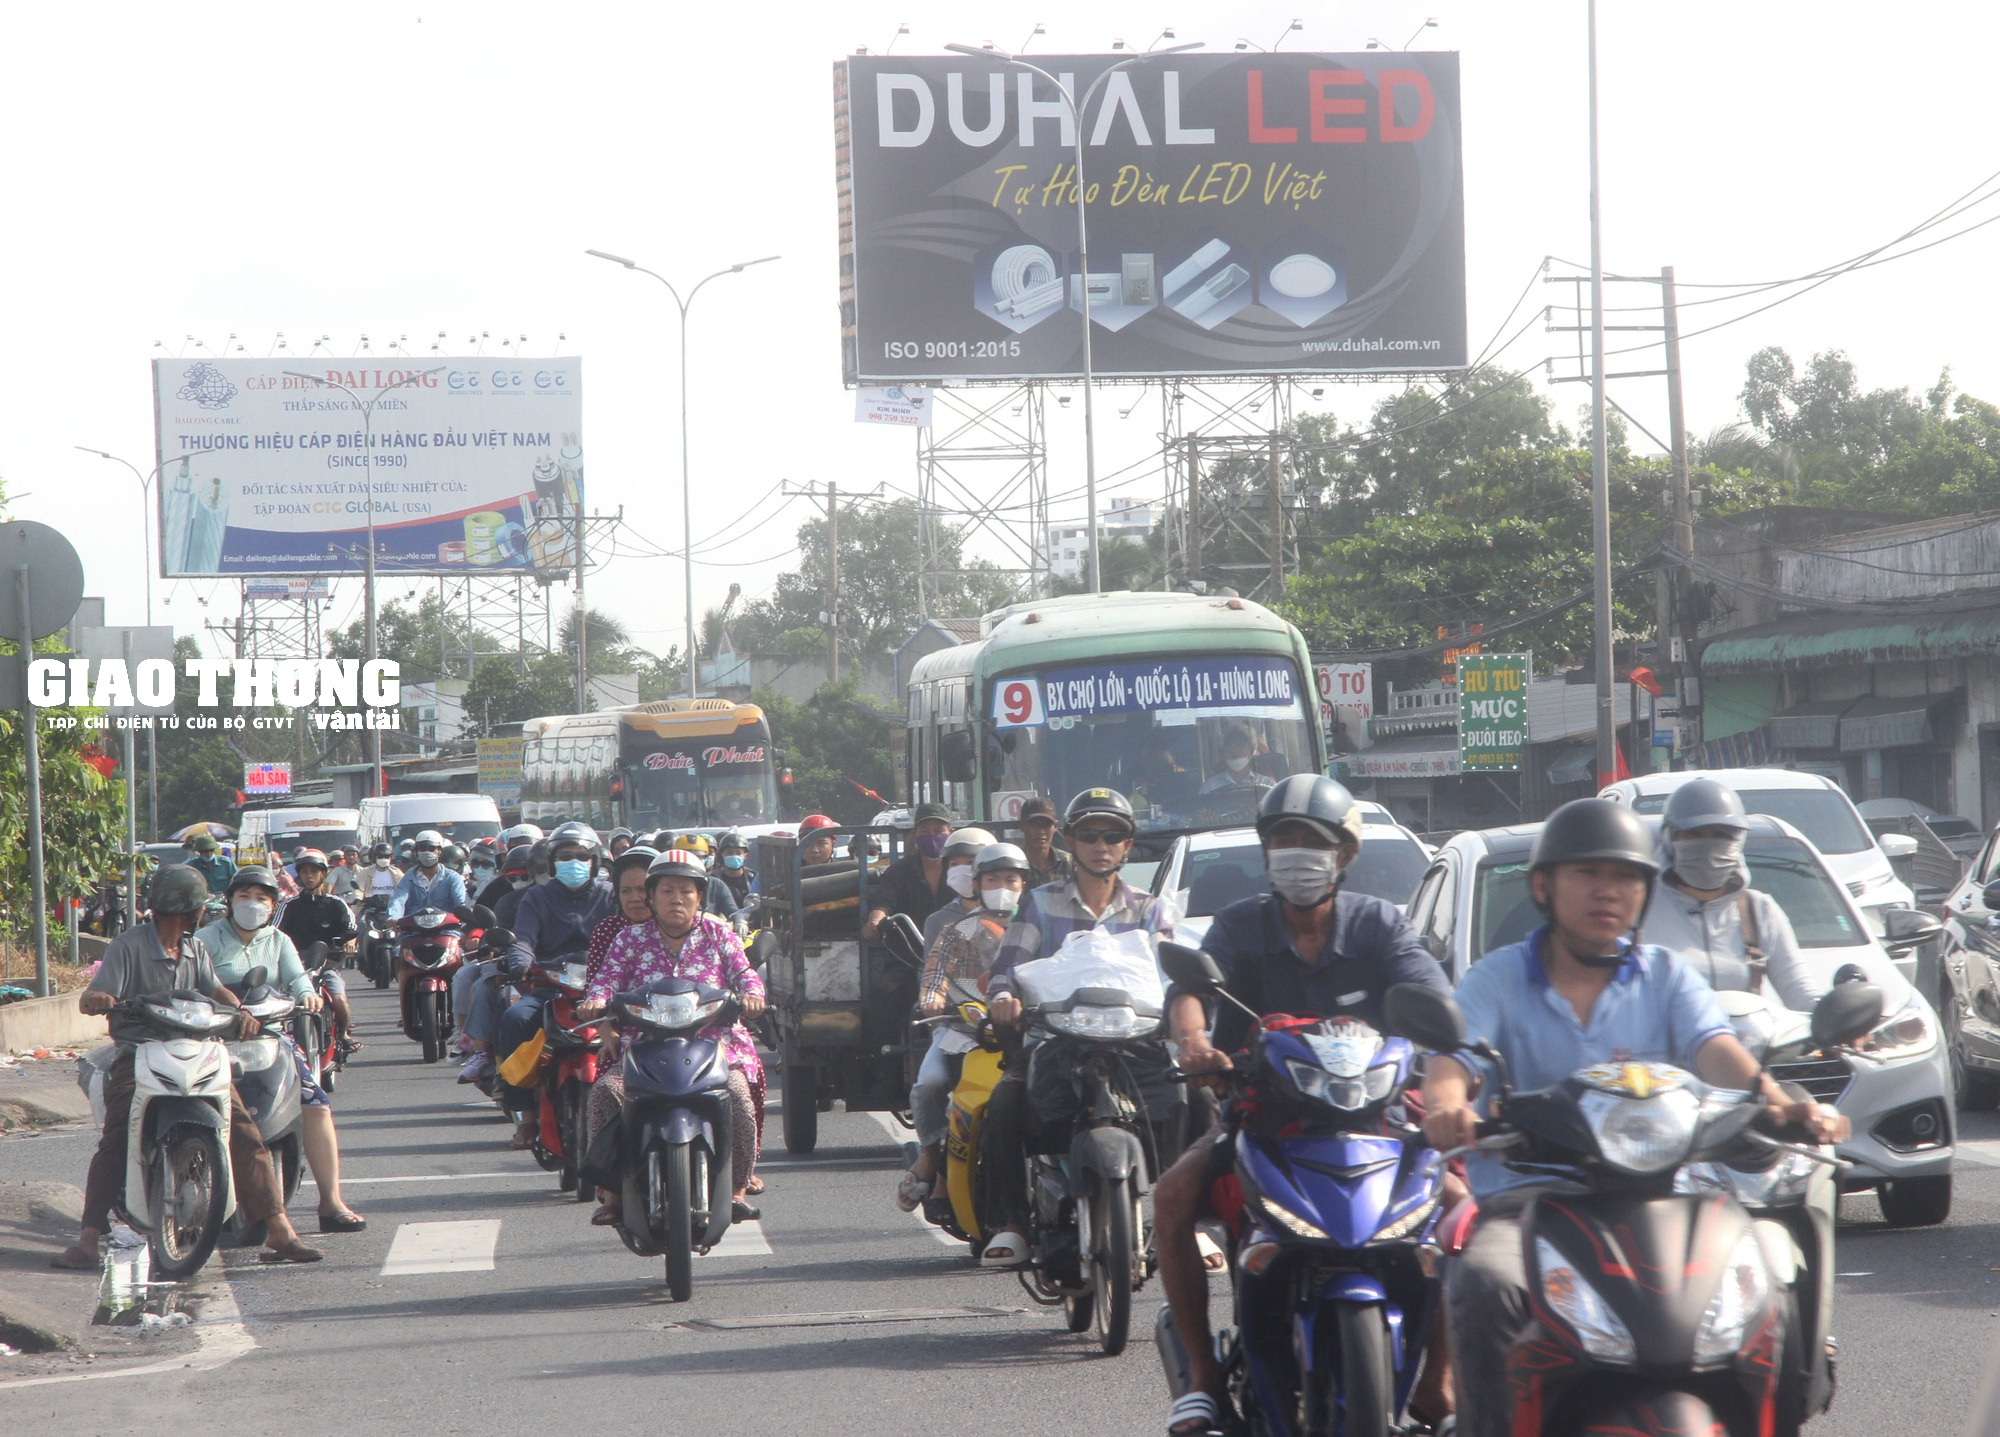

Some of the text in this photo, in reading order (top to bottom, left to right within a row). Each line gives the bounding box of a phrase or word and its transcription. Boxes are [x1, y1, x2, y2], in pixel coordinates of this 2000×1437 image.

[877, 69, 1436, 147] DUHAL LED
[992, 163, 1034, 215] Tự
[1111, 163, 1170, 207] Đèn
[1178, 161, 1252, 205] LED
[1263, 161, 1327, 210] Việt
[884, 340, 1021, 359] ISO 9001:2015
[1301, 337, 1441, 352] www.duhal.com.vn
[246, 374, 277, 390] CÁP
[374, 370, 439, 389] LONG
[317, 398, 348, 411] SÁNG
[179, 427, 551, 452] THƯƠNG HIỆU CÁP ĐIỆN HÀNG ĐẦU VIỆT NAM
[327, 454, 408, 469] (SINCE 1990)
[266, 482, 288, 495] TÁC
[402, 480, 439, 494] NHIỆT
[254, 501, 431, 516] TẬP ĐOÀN CTC GLOBAL (USA)
[1465, 661, 1521, 692] HỦ TÍU
[1047, 682, 1066, 711] BX
[1068, 675, 1095, 714] CHỢ
[1099, 670, 1125, 707] LỚN
[1135, 666, 1170, 710] QUỐC
[1173, 667, 1191, 708] LỘ
[1195, 672, 1212, 701] 1A
[1257, 670, 1291, 699] LONG
[1003, 681, 1032, 724] 9
[1471, 696, 1518, 724] MỰC
[1467, 727, 1522, 746] ĐUÔI HEO
[643, 745, 765, 770] Đức Phát
[249, 767, 287, 786] HẢI SẢN
